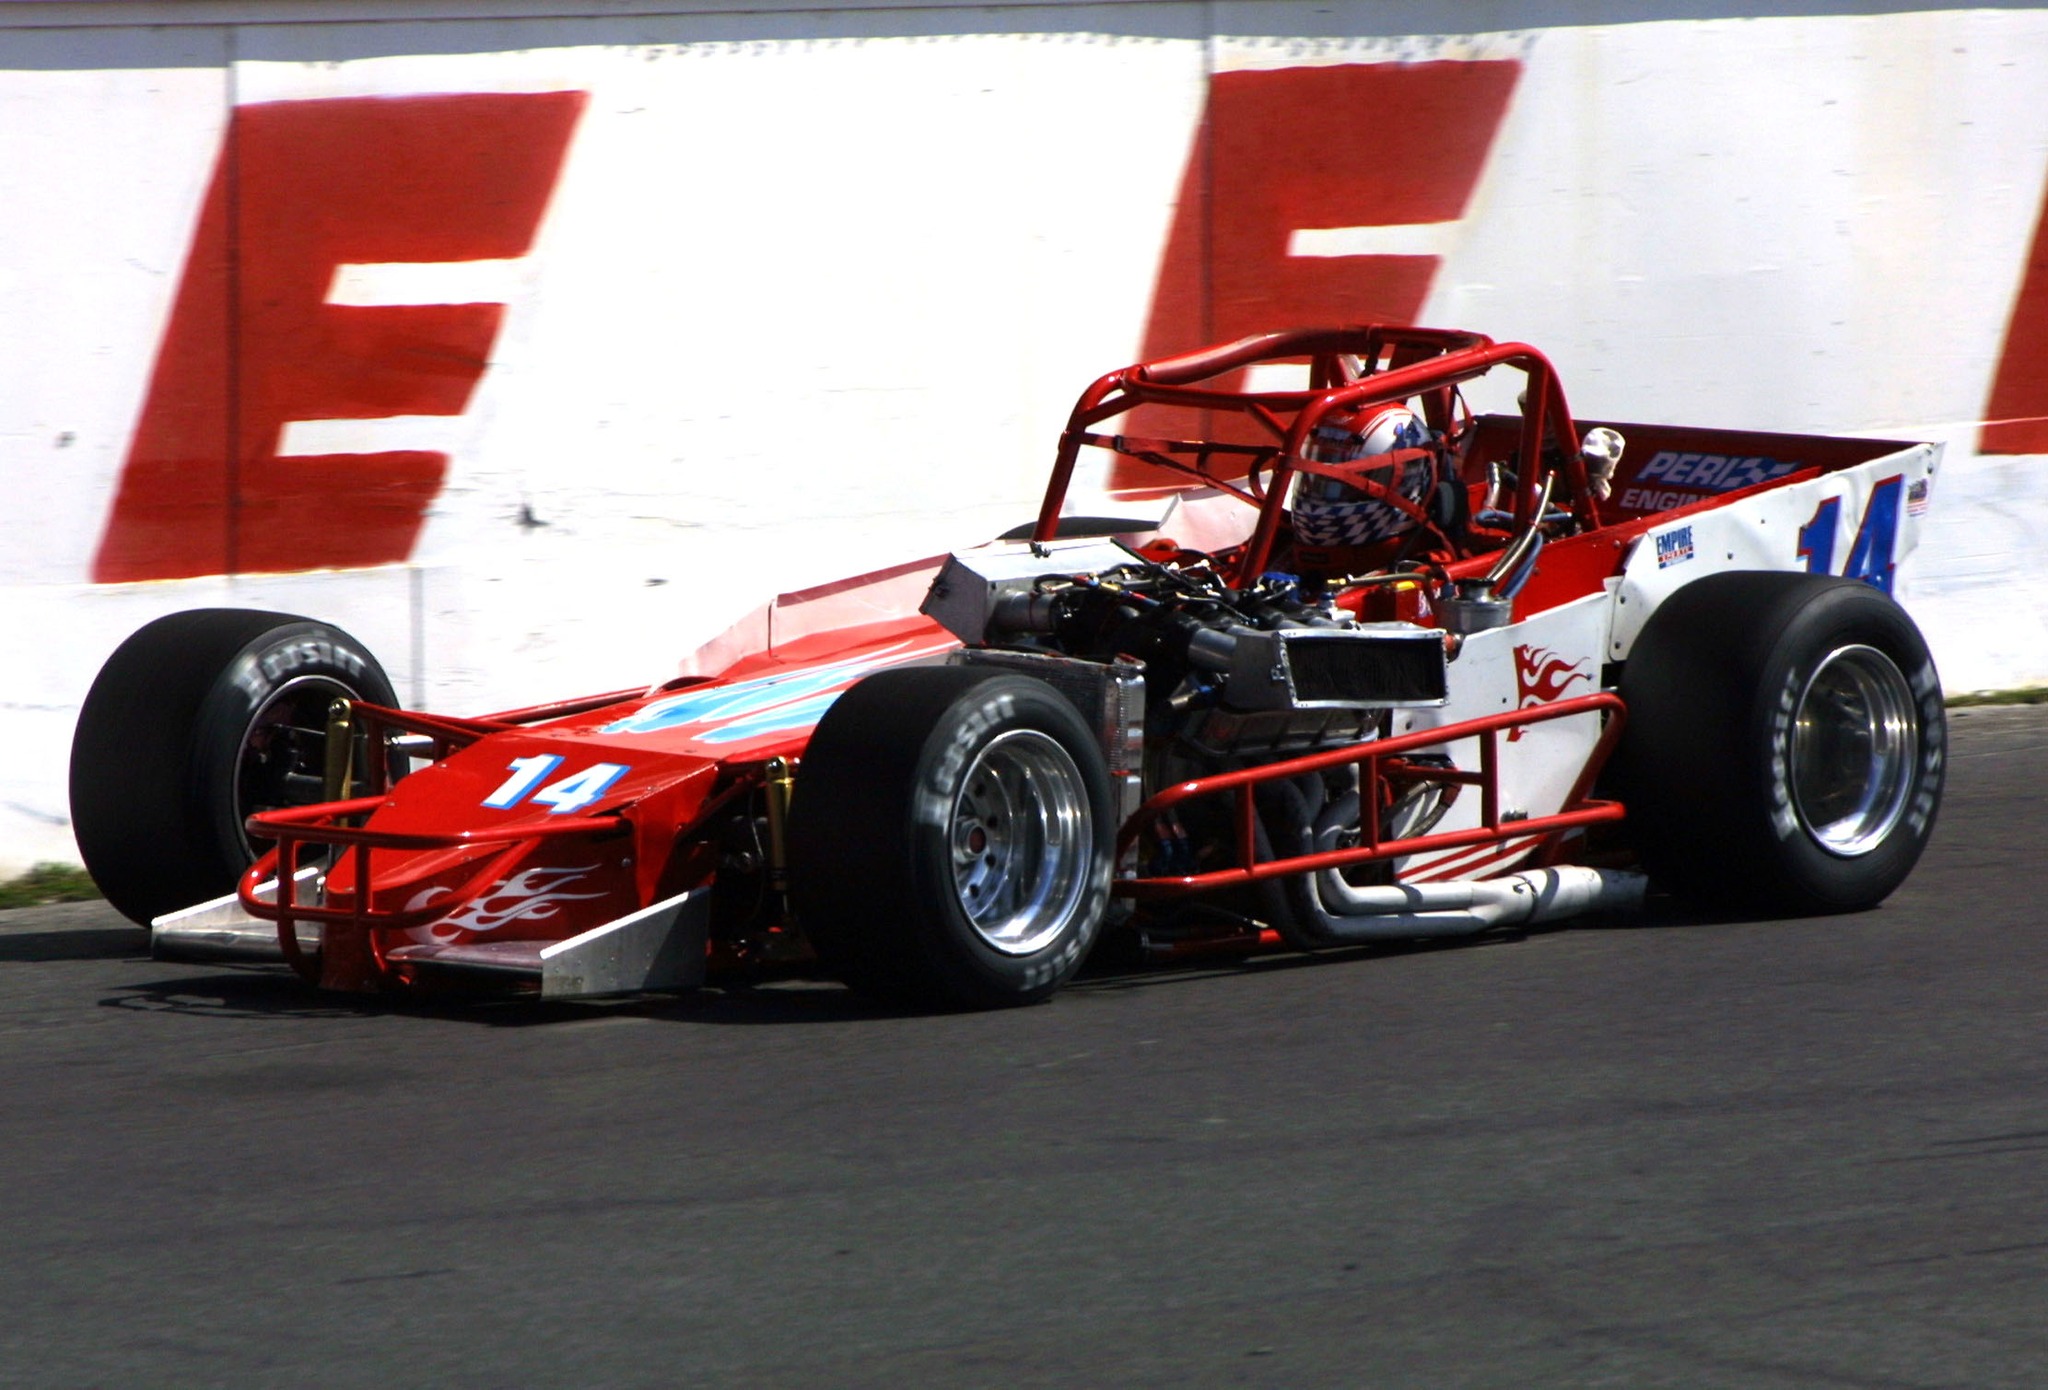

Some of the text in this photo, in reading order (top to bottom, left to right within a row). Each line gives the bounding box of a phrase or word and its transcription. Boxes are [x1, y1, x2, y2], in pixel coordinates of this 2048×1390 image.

[1656, 526, 1694, 556] EMPIRE
[1796, 473, 1904, 599] 14
[480, 753, 633, 814] 14
